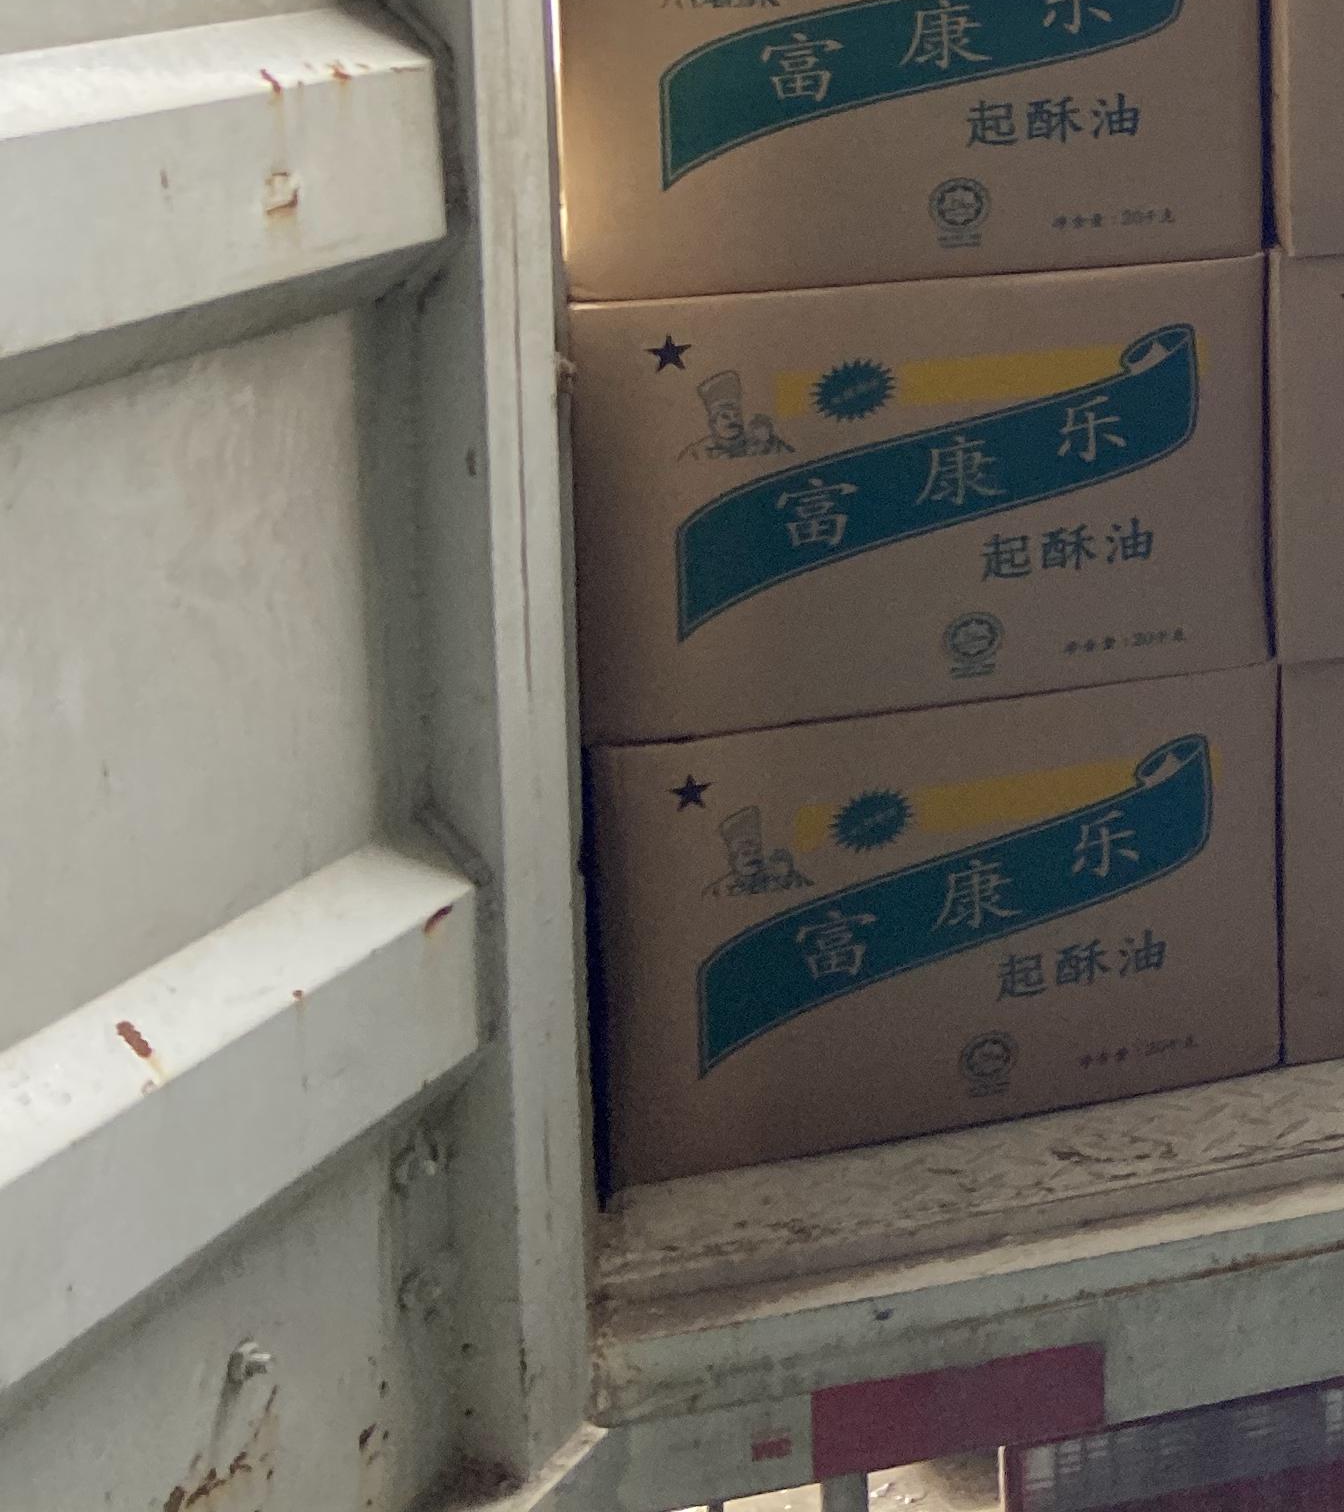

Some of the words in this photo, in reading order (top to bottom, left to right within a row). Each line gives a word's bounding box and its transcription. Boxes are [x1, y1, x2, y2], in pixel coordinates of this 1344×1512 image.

[967, 94, 1140, 147] 起酥油
[775, 396, 1126, 549] 富康乐
[981, 517, 1154, 581] 起酥油
[796, 811, 1139, 980] 富康乐
[997, 929, 1167, 1001] 起酥油
